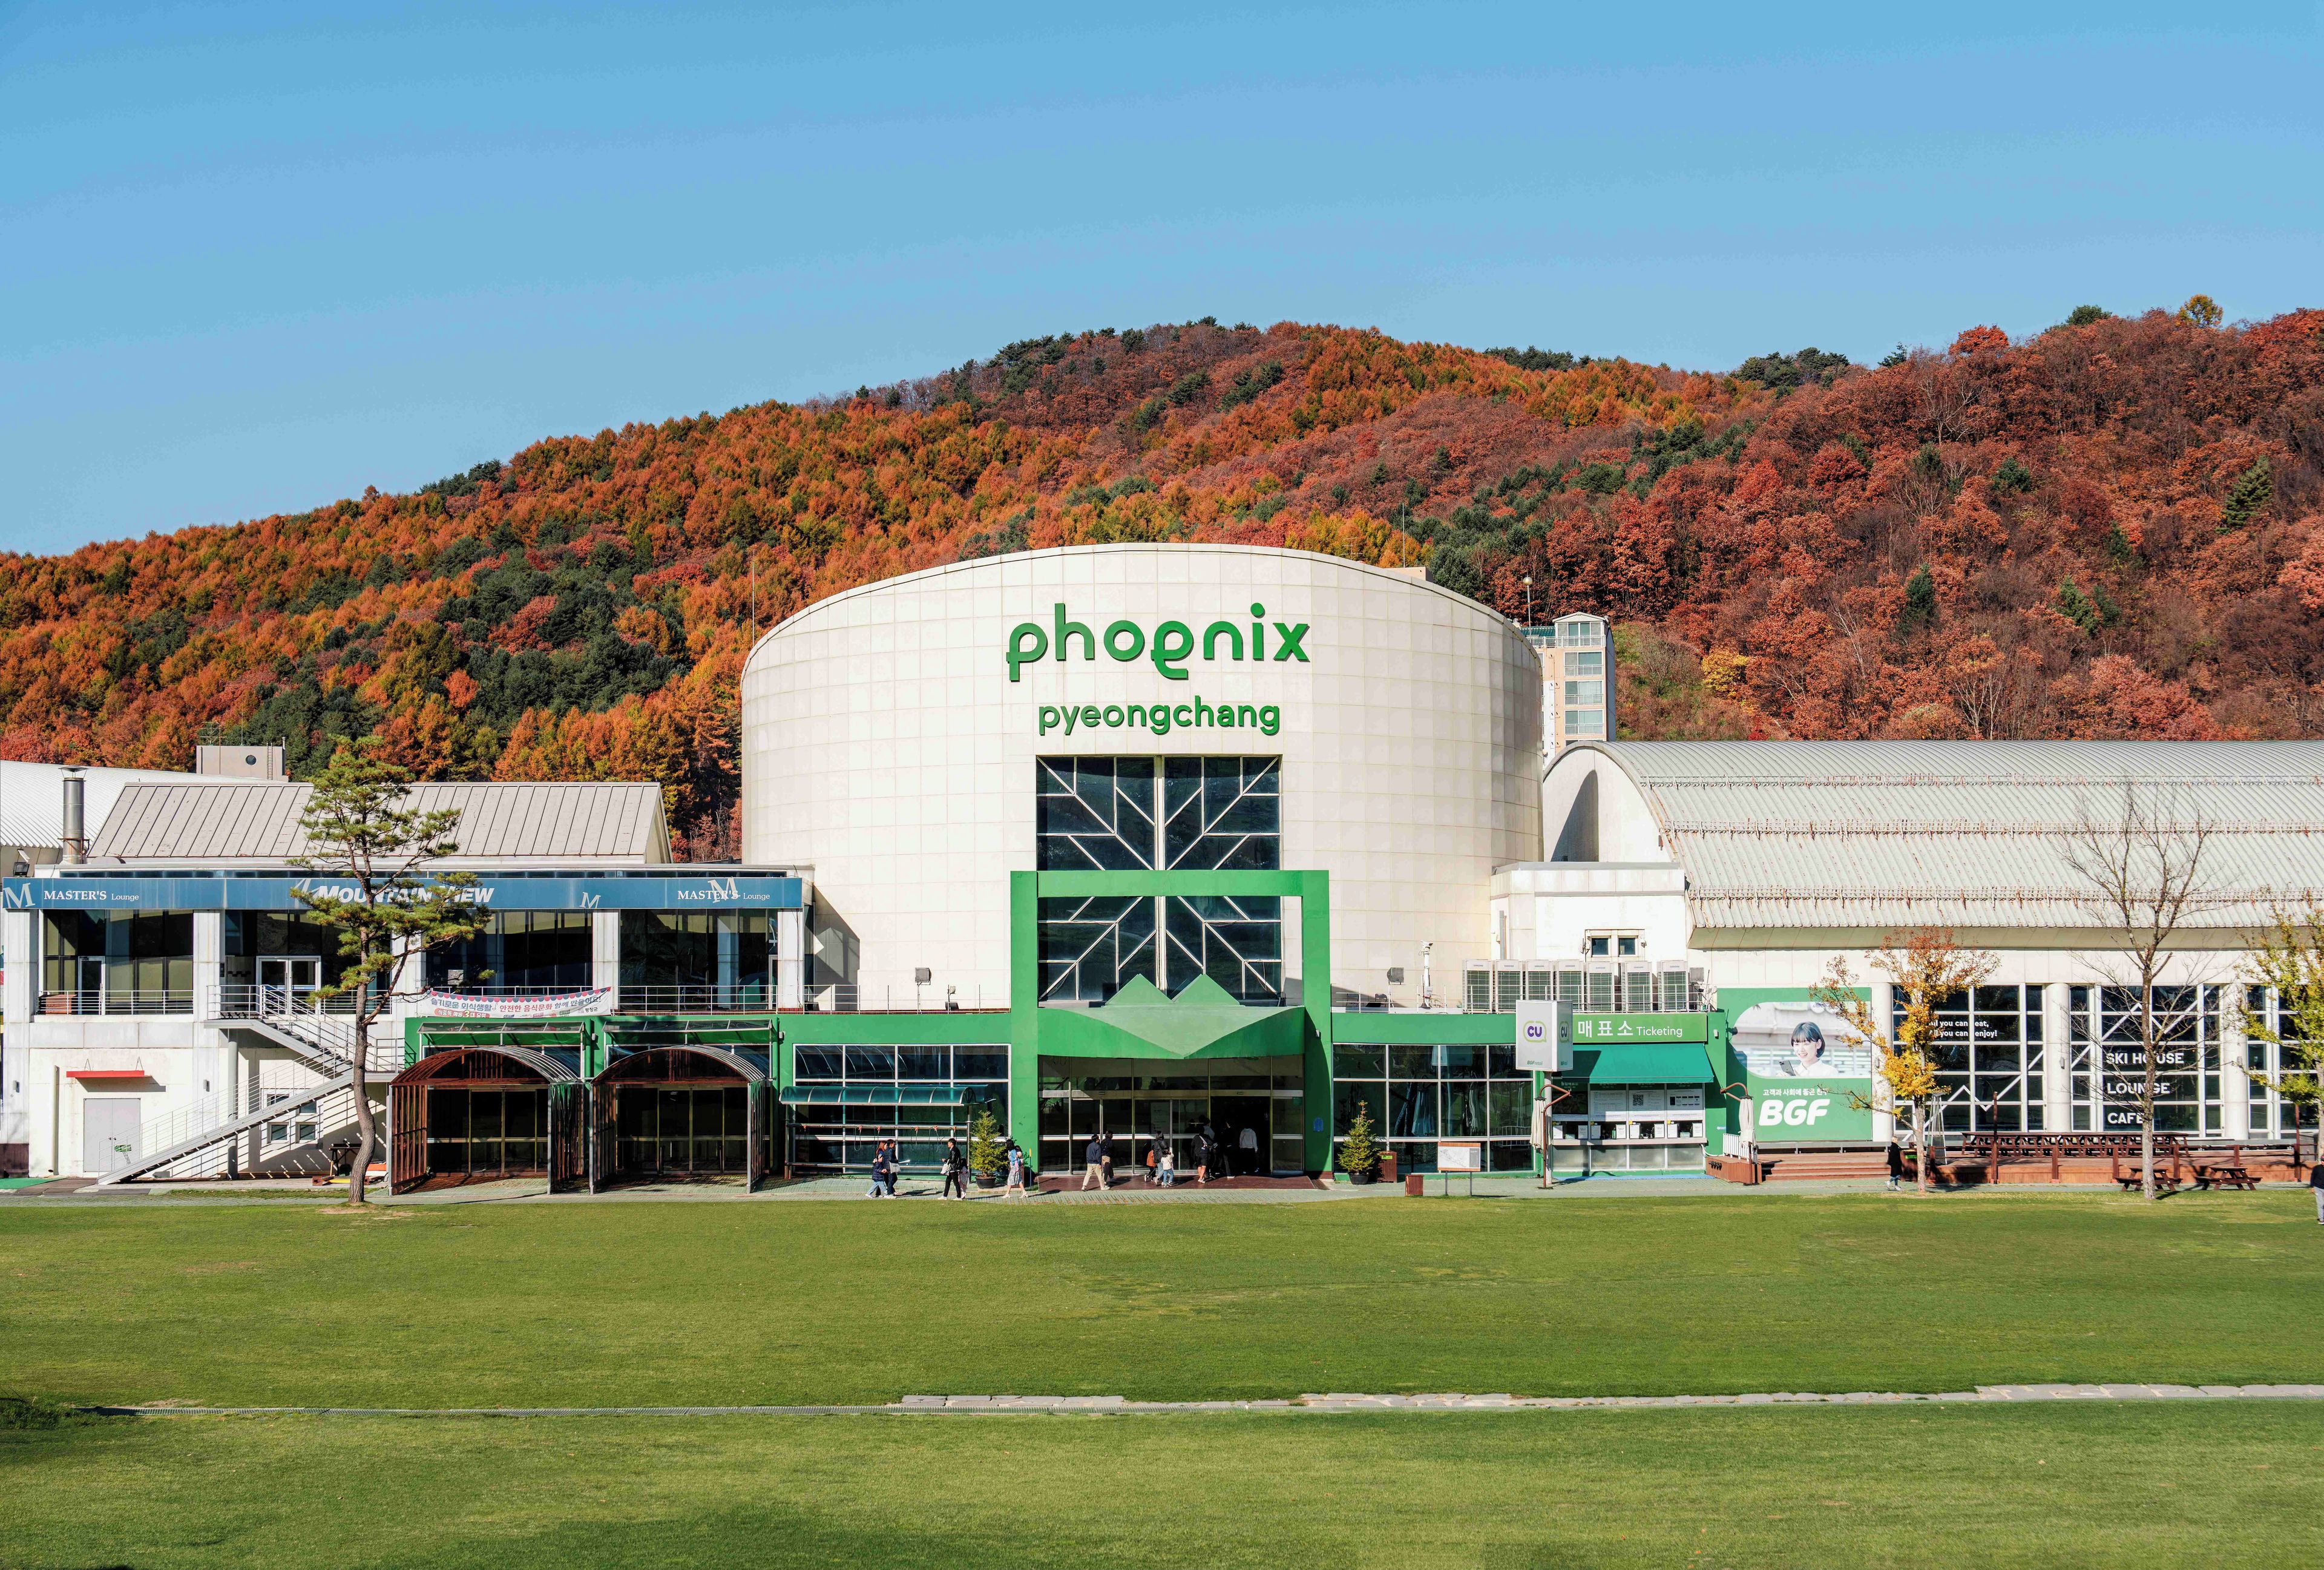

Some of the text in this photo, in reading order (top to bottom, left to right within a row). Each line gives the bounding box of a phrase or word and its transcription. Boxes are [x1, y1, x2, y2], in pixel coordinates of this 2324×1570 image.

[1006, 602, 1310, 682] phoenix
[1039, 695, 1280, 736] pyeongchang
[44, 890, 107, 901] MASTER'S
[677, 890, 738, 899] MASTER'S
[461, 1002, 492, 1011] 외식생활
[524, 1003, 553, 1012] 음식문화
[571, 996, 601, 1007] 만들어요!
[1527, 1025, 1542, 1037] CU
[1561, 1025, 1567, 1037] CU
[1636, 1026, 1683, 1037] Ticketing
[1974, 1030, 1998, 1039] enjoy!
[2106, 1053, 2128, 1065] SKI
[1759, 1099, 1831, 1126] BGF
